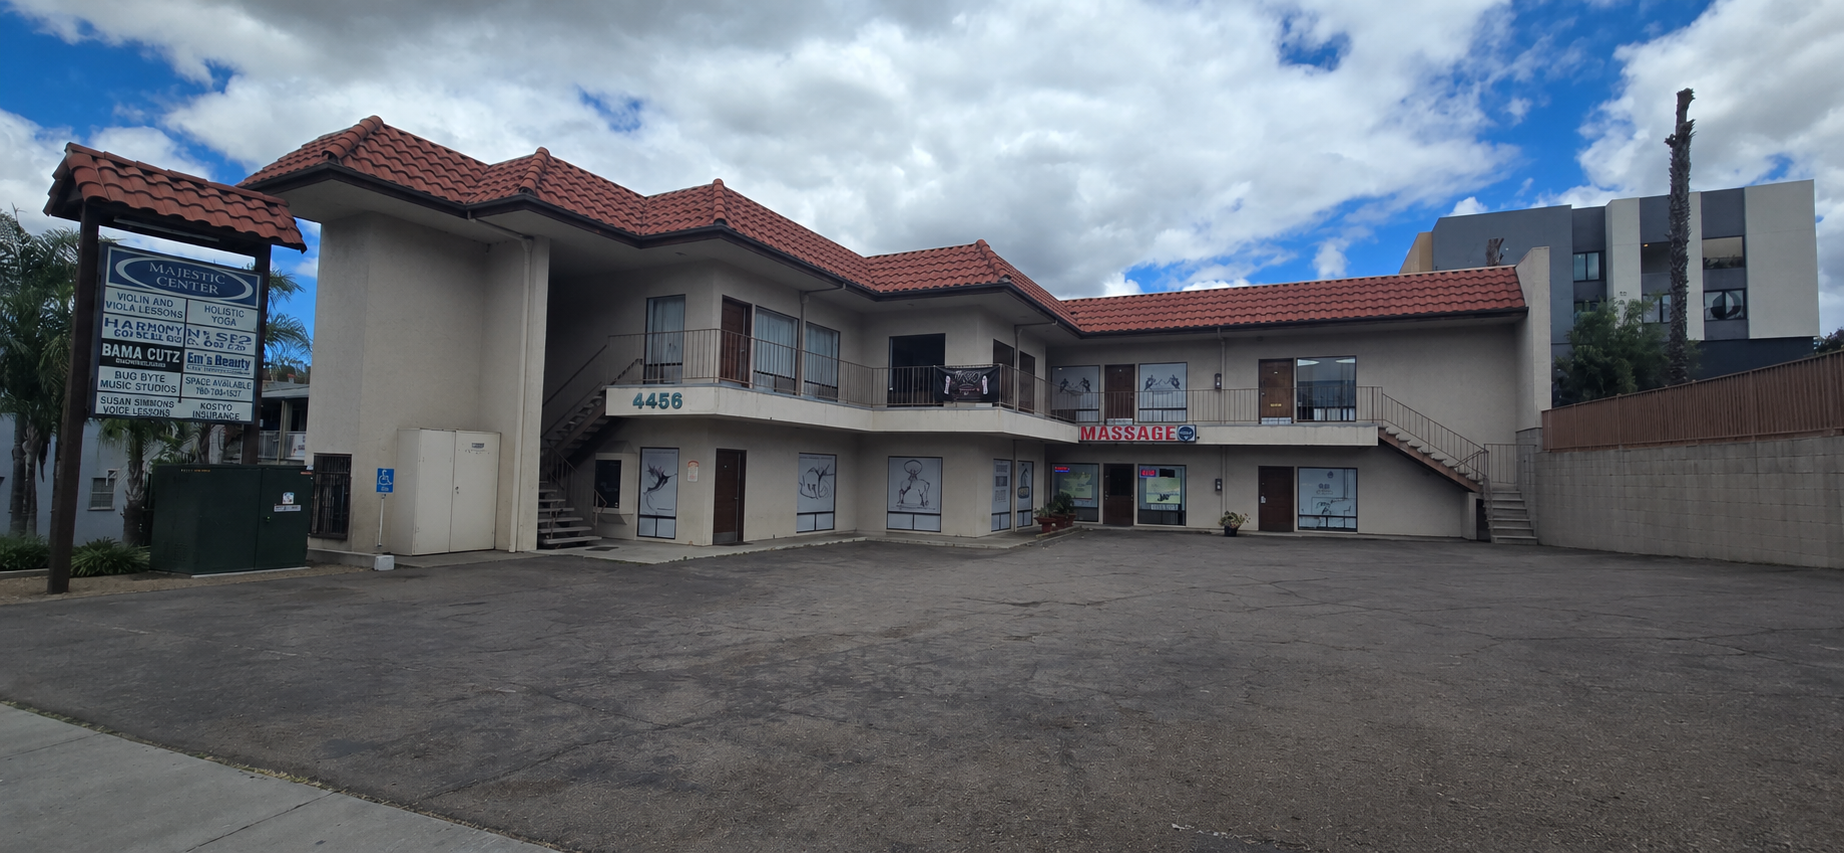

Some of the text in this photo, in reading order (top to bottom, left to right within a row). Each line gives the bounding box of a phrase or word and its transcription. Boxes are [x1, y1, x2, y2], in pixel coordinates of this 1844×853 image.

[148, 262, 226, 285] MAJESTIC
[156, 277, 219, 295] CENTER
[117, 292, 173, 307] VIOLIN AND
[106, 301, 183, 318] VIOLA LESSONS
[204, 305, 245, 318] HOLISTIC
[104, 317, 182, 335] HARMONY
[212, 316, 237, 326] YOGA
[102, 343, 142, 359] BAMA
[147, 348, 181, 363] CUTZ
[187, 352, 212, 365] Em's
[215, 354, 250, 370] Beauty
[114, 371, 166, 382] BUG BYTE
[185, 377, 251, 390] SPACE AVAILABLE
[100, 380, 177, 393] MUSIC STUDIOS
[100, 396, 174, 408] SUSAN SIMMONS
[632, 393, 683, 410] 4456
[103, 406, 130, 414] VOICE
[1080, 426, 1176, 440] MASSAGE
